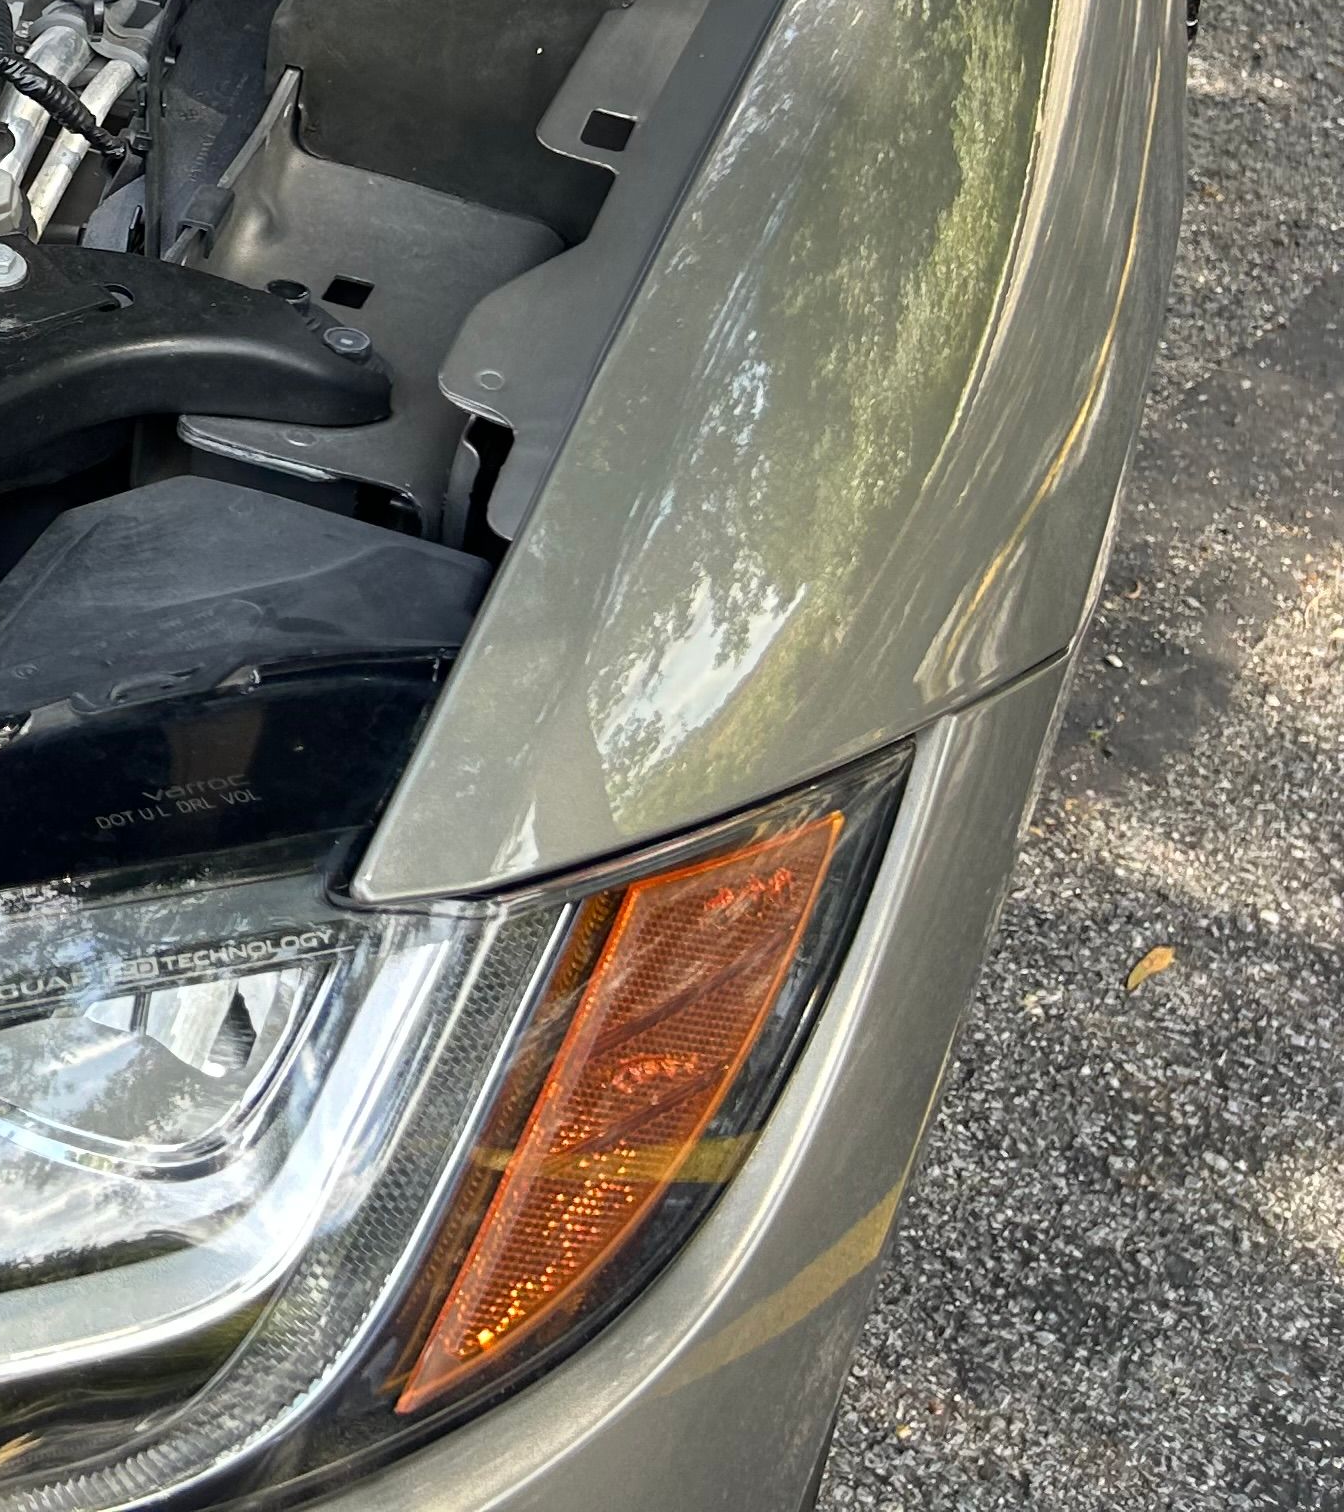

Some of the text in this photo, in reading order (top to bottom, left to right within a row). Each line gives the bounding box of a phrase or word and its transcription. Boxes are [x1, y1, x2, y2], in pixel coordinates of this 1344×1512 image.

[95, 789, 262, 830] DOT U L DRL VOL
[161, 930, 334, 970] TECHNOLOGY
